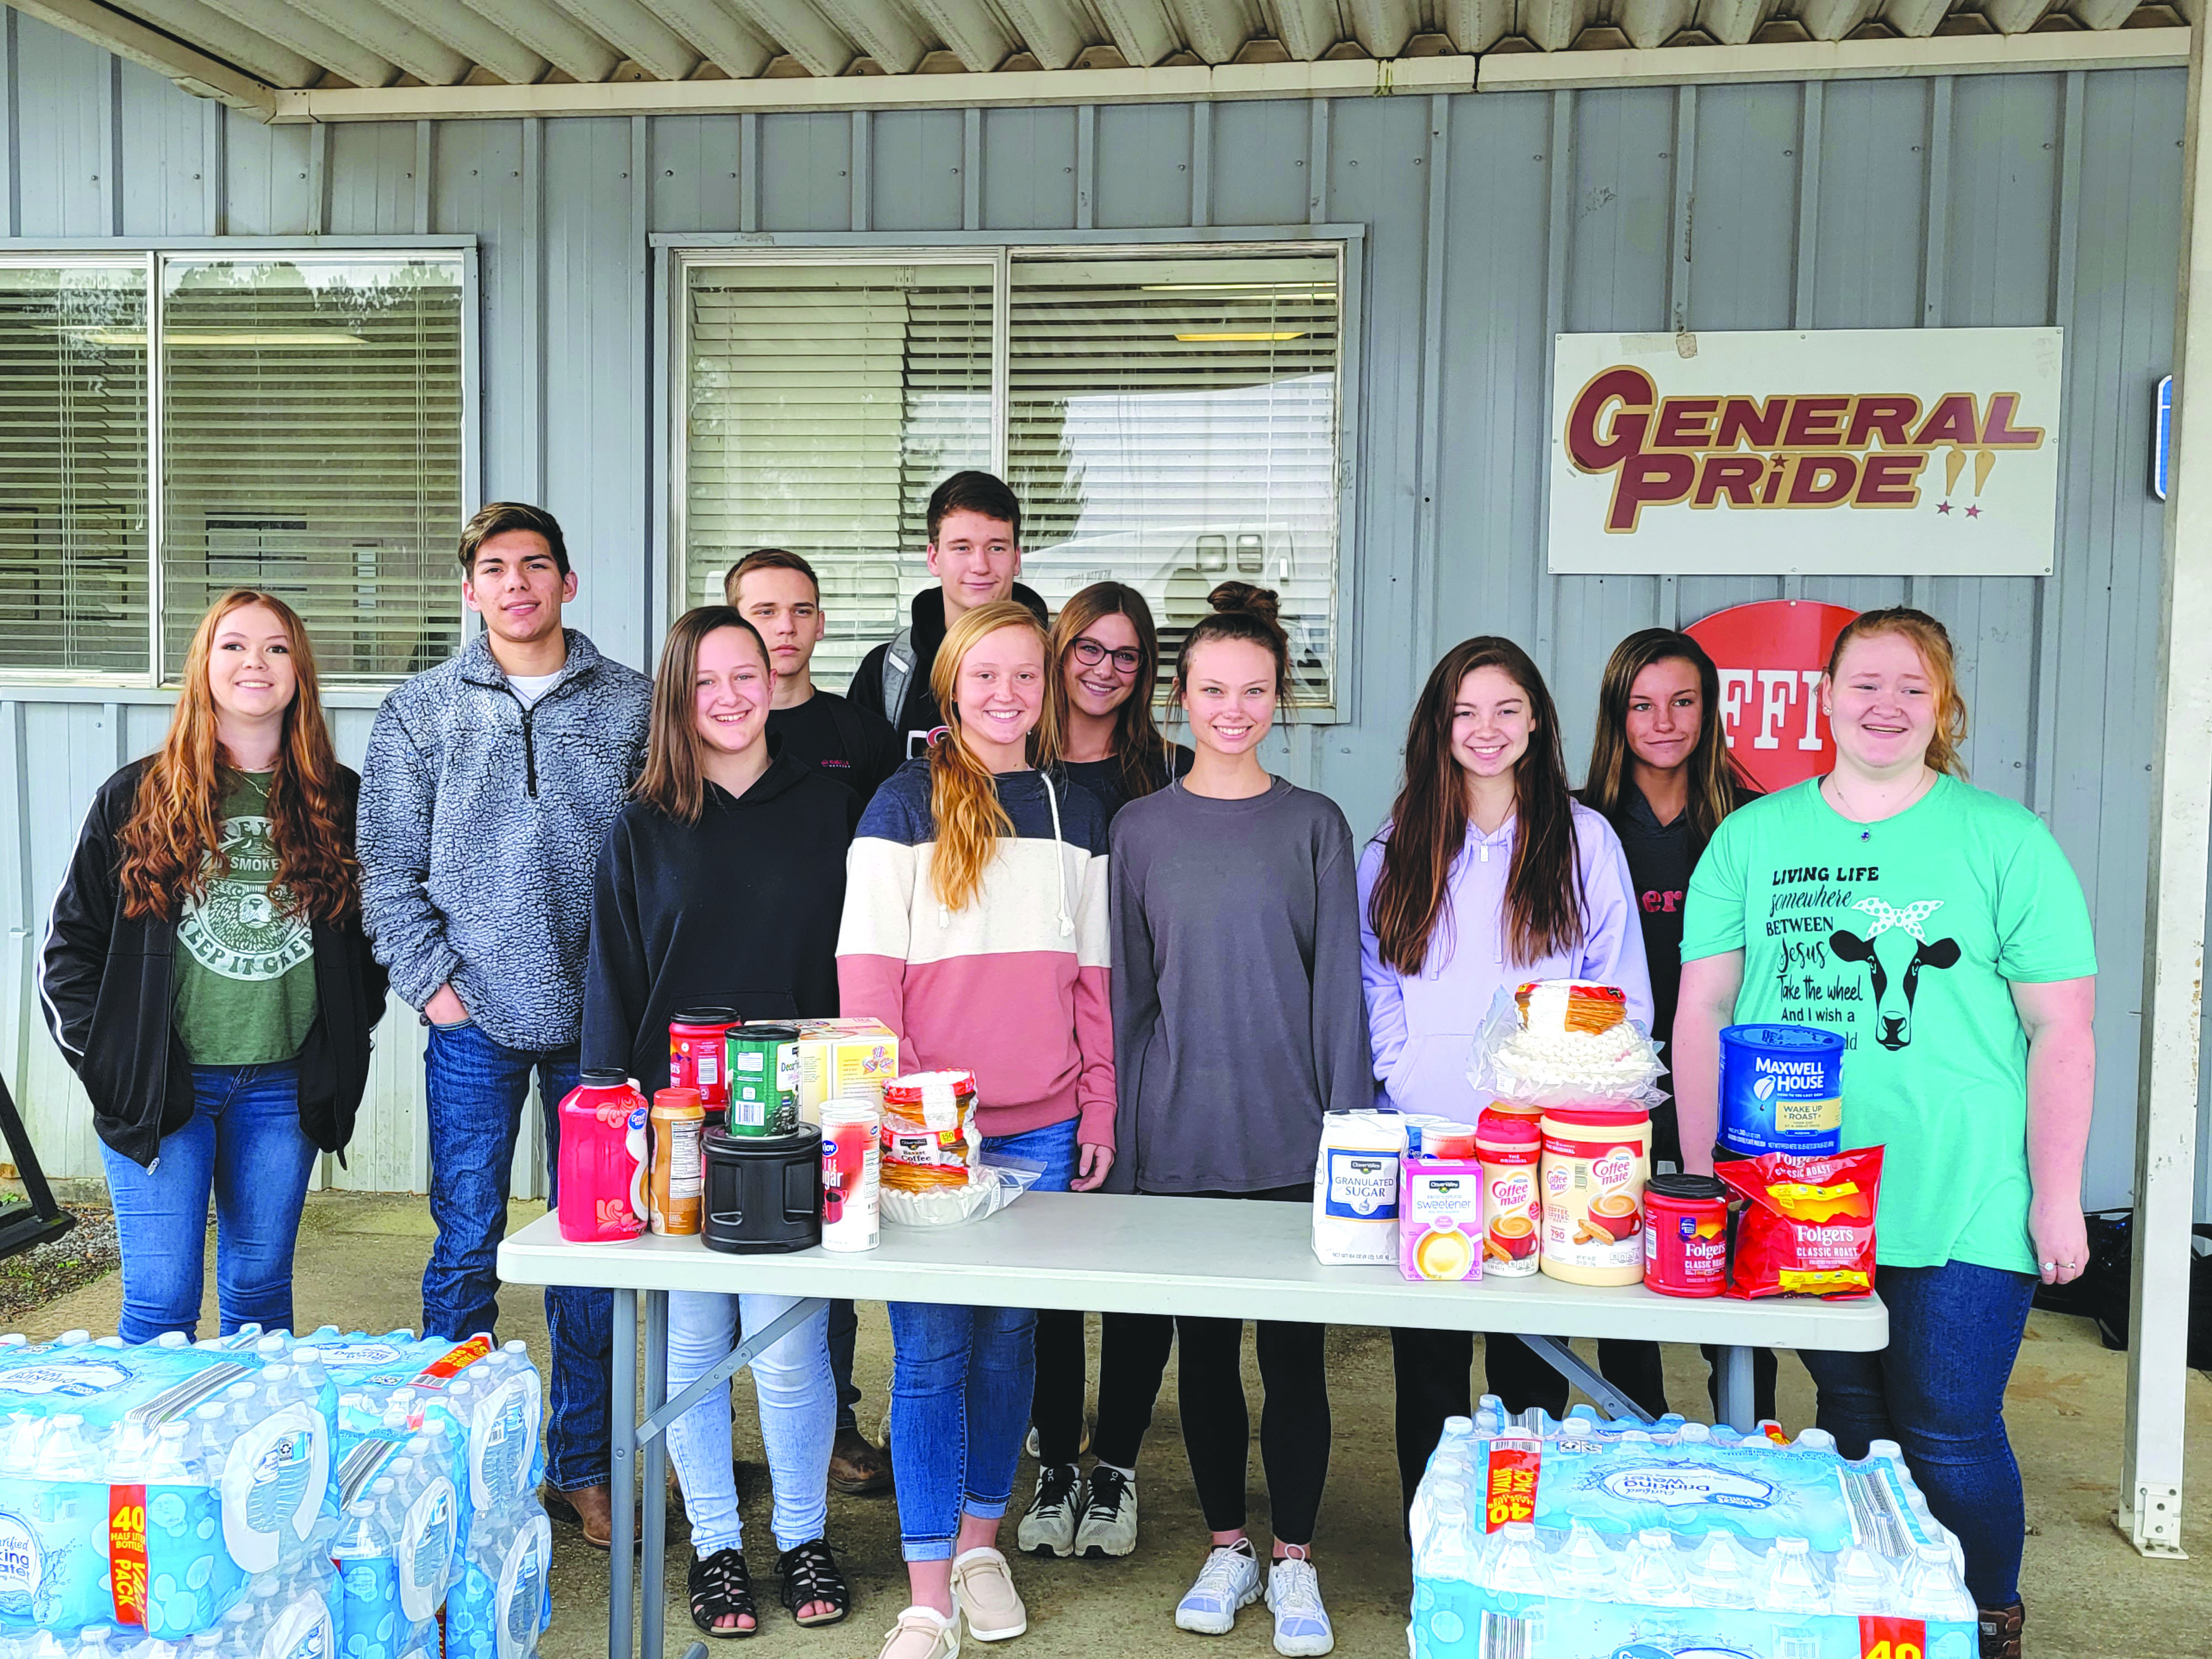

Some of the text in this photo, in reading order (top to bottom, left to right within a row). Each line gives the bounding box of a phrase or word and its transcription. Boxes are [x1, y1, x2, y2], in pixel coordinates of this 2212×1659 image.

[1564, 364, 2045, 474] GENERAL
[1717, 669, 1823, 751] FFI
[230, 857, 281, 872] SMOKE
[1772, 867, 1879, 886] LIVING LIFE
[1641, 890, 1683, 912] er
[1770, 884, 1852, 918] somewhere
[1766, 916, 1833, 936] BETWEEN
[228, 956, 255, 975] IT
[263, 931, 313, 974] GREE
[1777, 937, 1830, 973] Jesus
[1776, 974, 1863, 1003] Take the wheel
[1781, 1006, 1855, 1022] And I wish a
[1755, 1057, 1824, 1075] MAXWELL
[1777, 1074, 1824, 1092] HOUSE
[942, 1132, 954, 1140] 150
[1547, 1170, 1568, 1184] Coffee
[1593, 1159, 1630, 1178] Coffee
[1807, 1165, 1831, 1177] ROAST
[1335, 1177, 1394, 1186] GRANULATED
[1601, 1171, 1629, 1185] mate
[1345, 1186, 1385, 1197] SUGAR
[1492, 1181, 1528, 1198] Coffee
[1417, 1199, 1471, 1209] sweetener
[1500, 1194, 1527, 1206] mate
[1550, 1229, 1564, 1239] 790
[1797, 1225, 1854, 1246] Folgers
[1685, 1243, 1725, 1260] Folgers
[1797, 1247, 1859, 1258] CLASSIC ROAST
[1684, 1260, 1712, 1269] CLASSIC
[1624, 1475, 1685, 1485] Water
[1624, 1480, 1710, 1491] Drinking
[112, 1506, 145, 1532] 40
[1490, 1503, 1531, 1524] 40
[111, 1532, 131, 1542] HALF
[114, 1559, 136, 1608] PACK
[1865, 1641, 1922, 1659] 40
